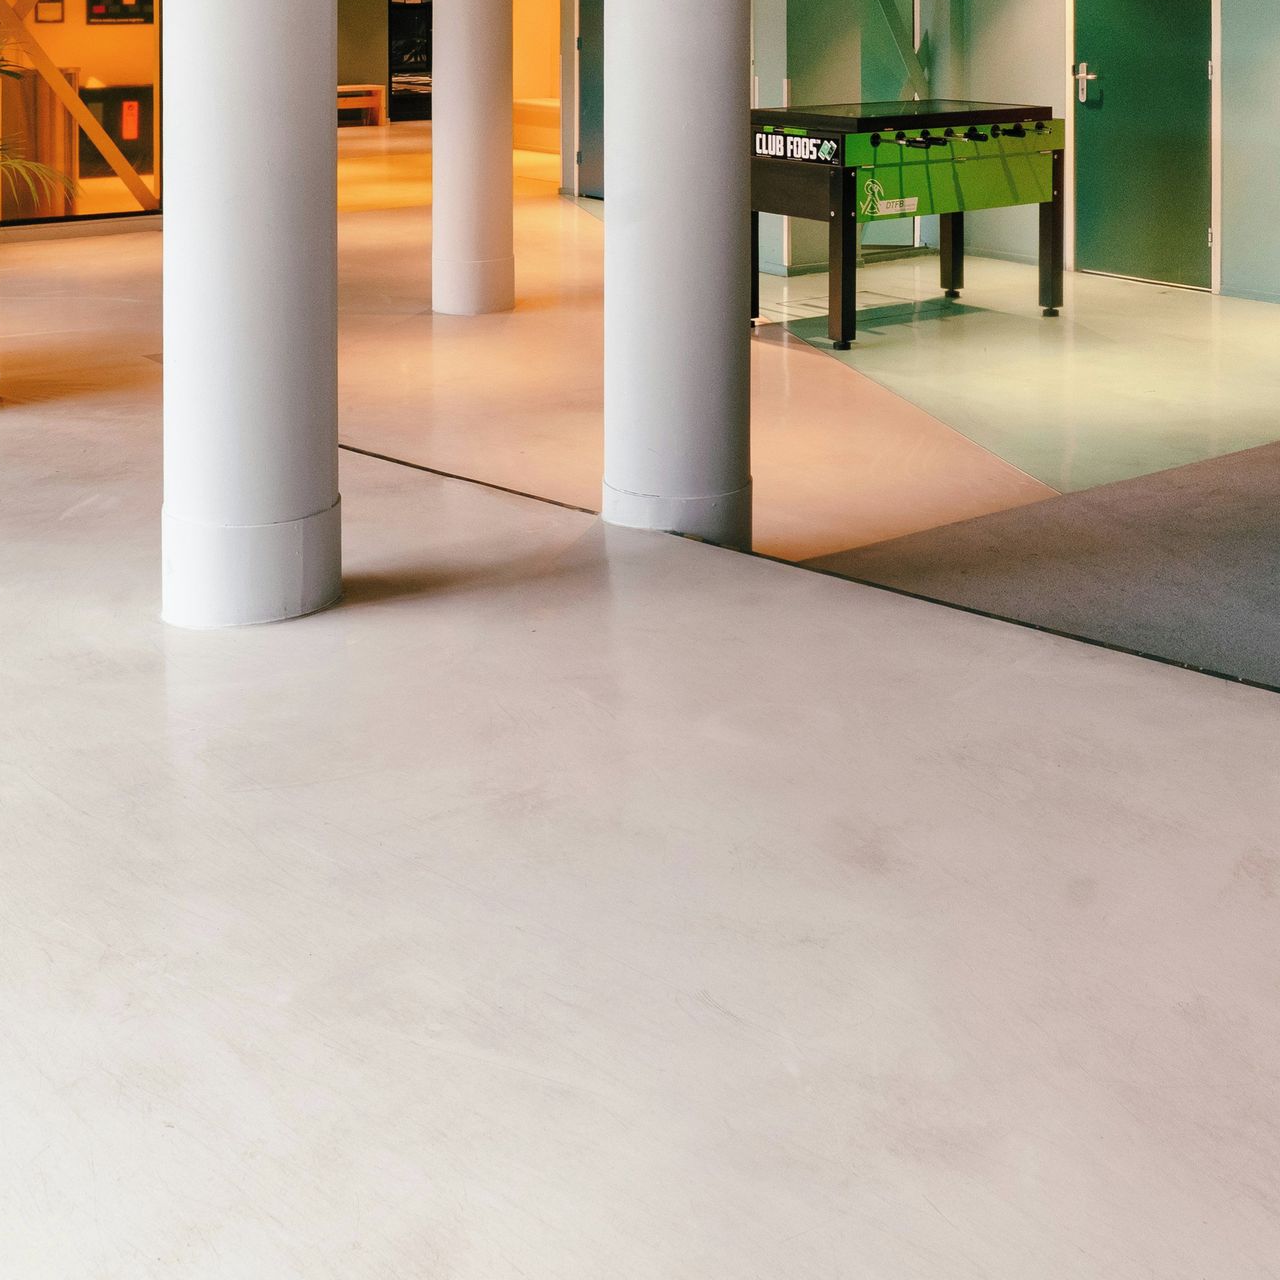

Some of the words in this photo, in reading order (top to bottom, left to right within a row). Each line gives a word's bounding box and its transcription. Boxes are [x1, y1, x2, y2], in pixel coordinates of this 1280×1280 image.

[755, 132, 784, 156] CLUB
[786, 136, 817, 160] FOOS
[886, 199, 905, 210] DTFB
